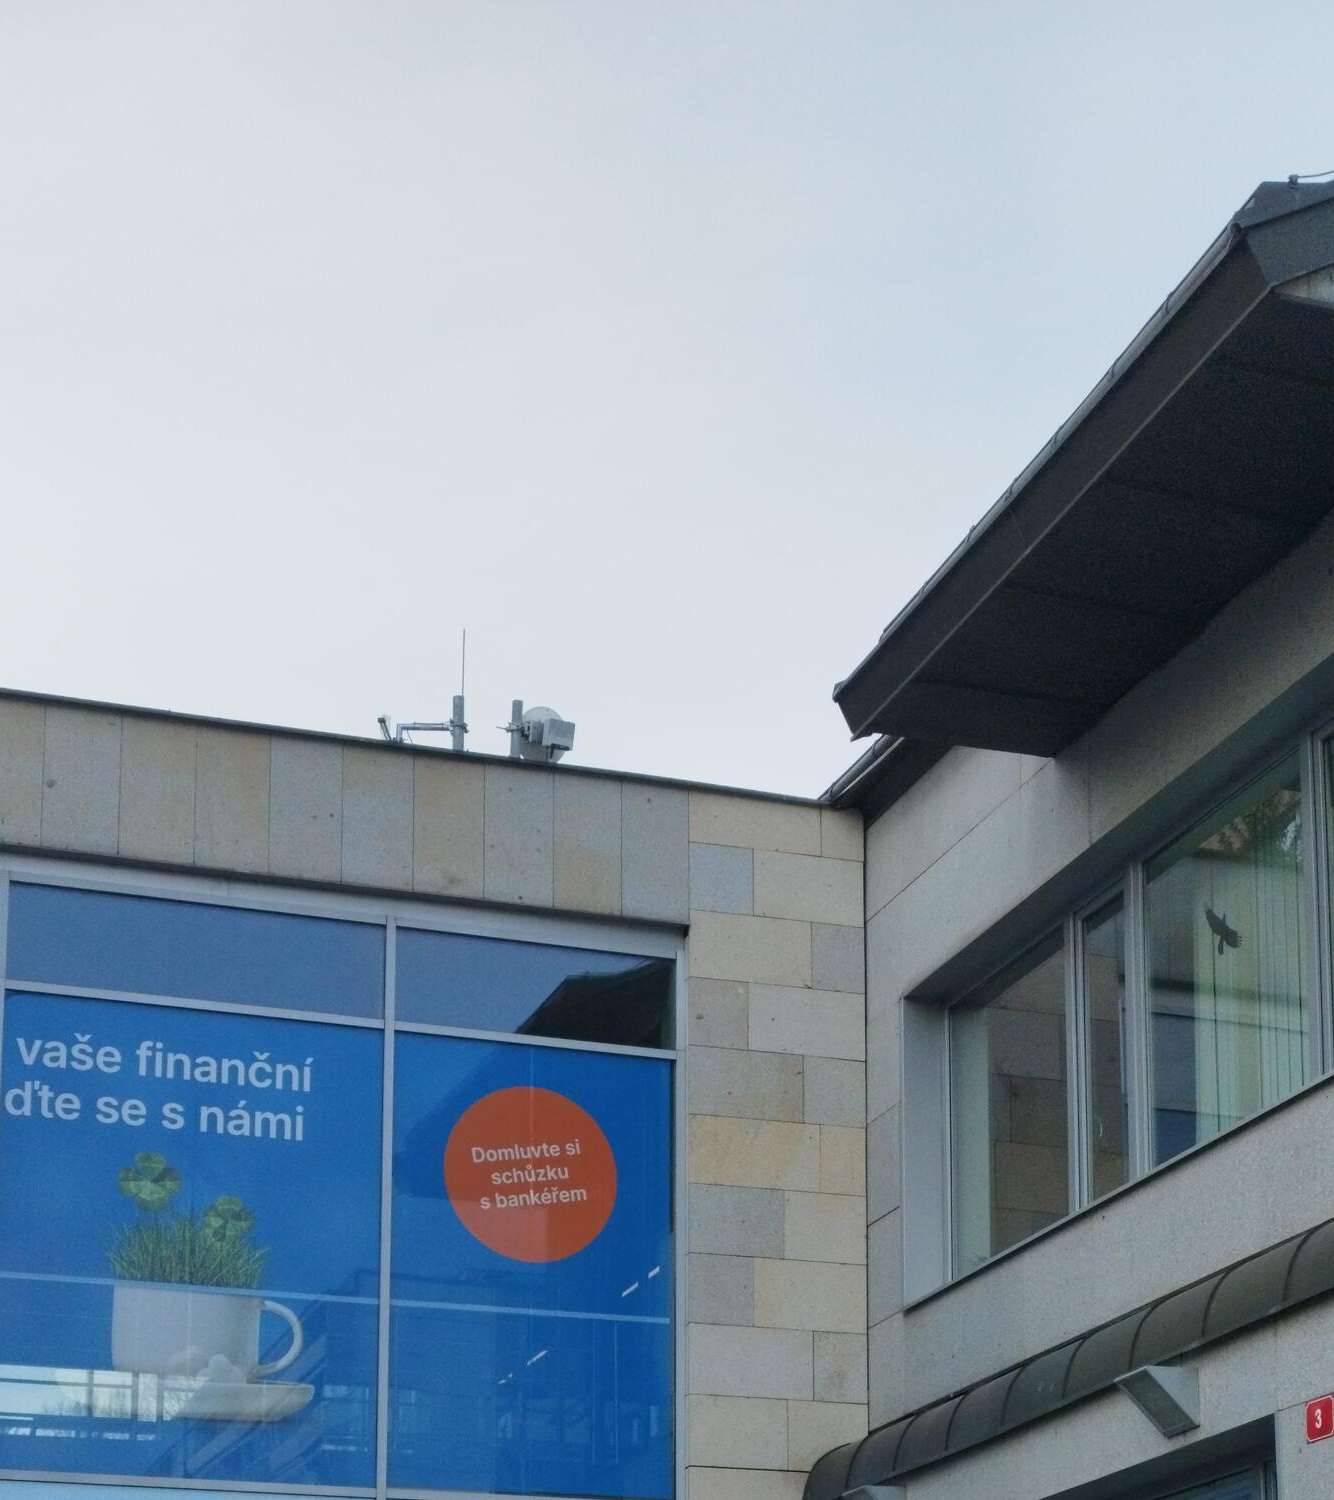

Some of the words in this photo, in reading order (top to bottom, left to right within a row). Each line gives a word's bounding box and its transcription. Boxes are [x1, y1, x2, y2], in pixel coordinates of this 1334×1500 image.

[16, 1033, 121, 1073] vaše
[135, 1040, 314, 1093] finanční
[96, 1099, 148, 1128] se
[161, 1103, 185, 1130] s
[199, 1101, 305, 1142] námi
[471, 1140, 561, 1163] Domluvte
[565, 1138, 581, 1156] si
[491, 1164, 570, 1185] schůzku
[480, 1196, 490, 1210] s
[496, 1186, 587, 1209] bankéřem
[1314, 1408, 1323, 1429] 3
